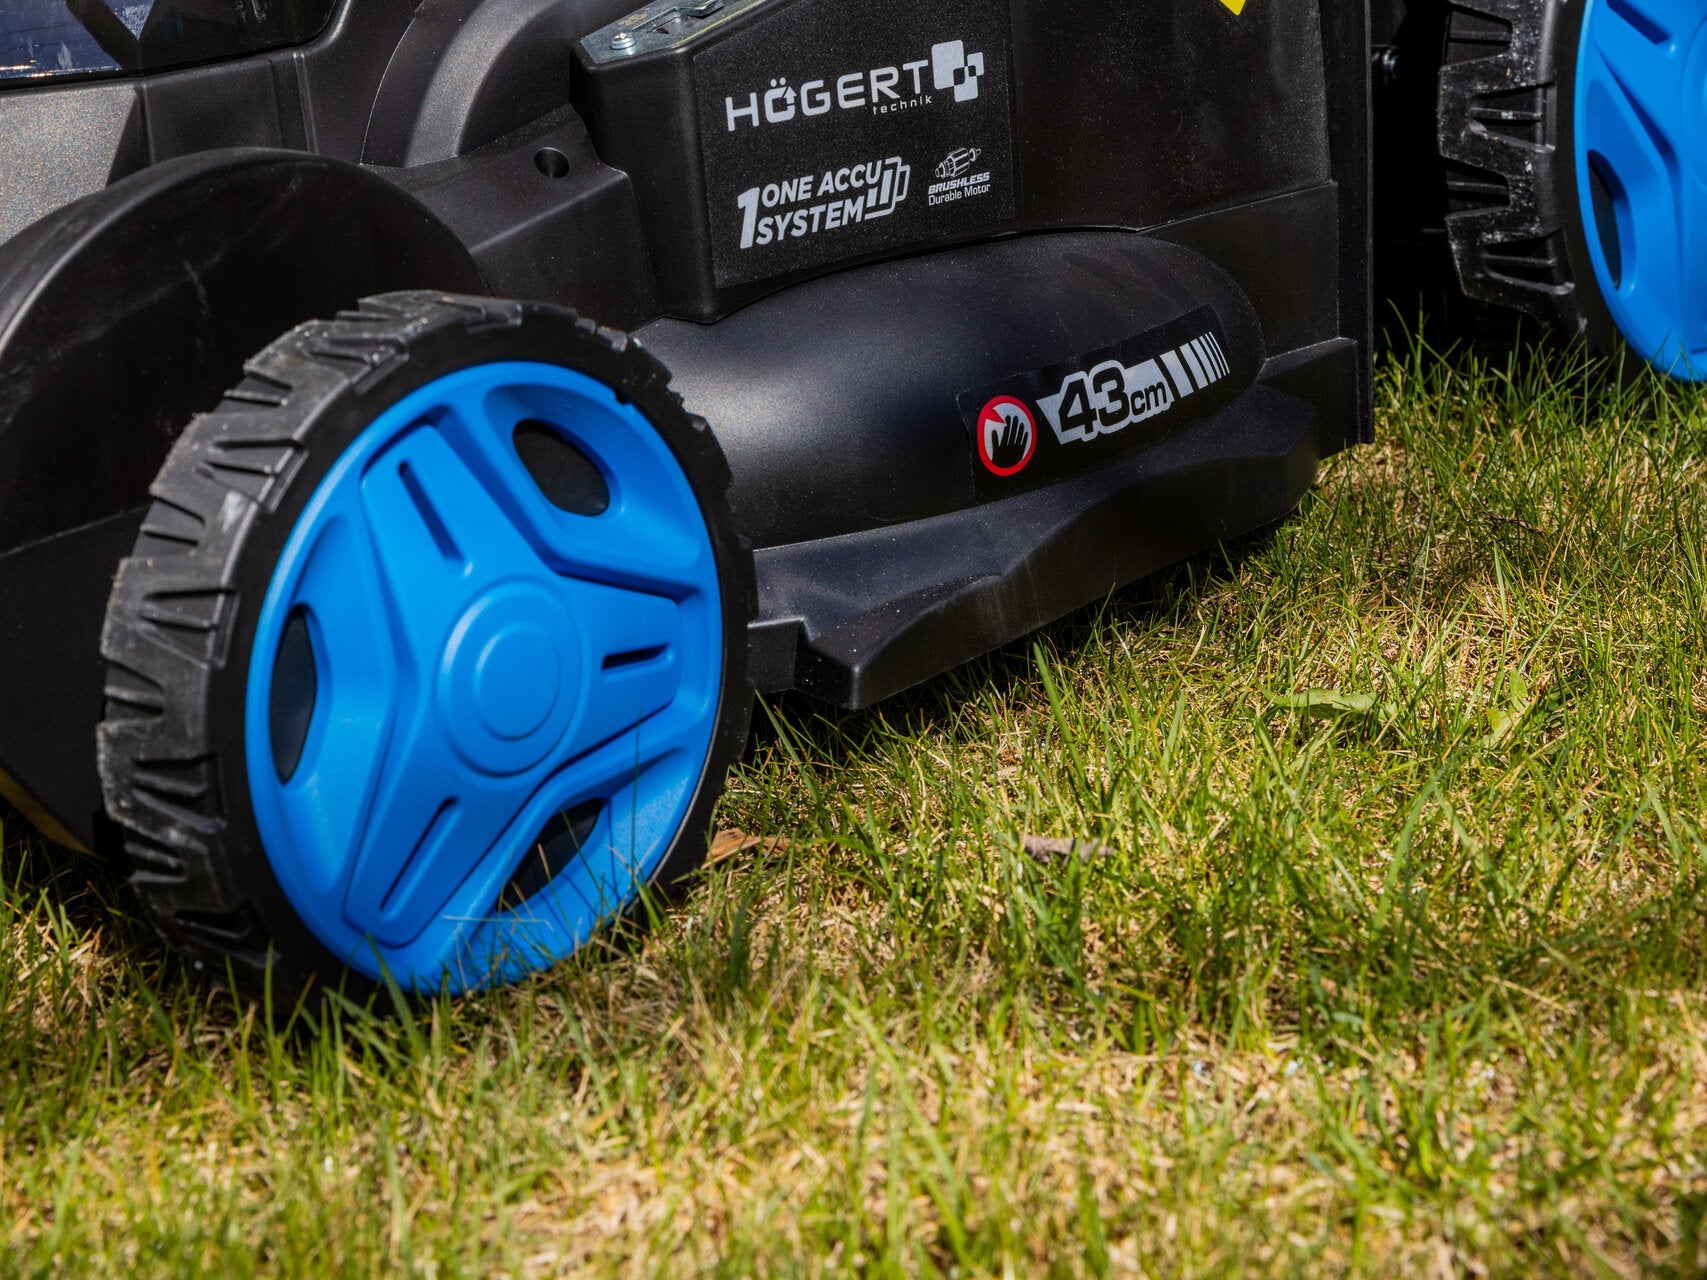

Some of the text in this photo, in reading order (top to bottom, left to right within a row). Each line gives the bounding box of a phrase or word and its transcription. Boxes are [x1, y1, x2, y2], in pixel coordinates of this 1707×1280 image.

[725, 59, 929, 132] HÖGERT
[872, 94, 933, 116] technik
[737, 160, 882, 250] 1 ONE ACCU
[928, 172, 991, 195] BRUSHLESS
[928, 183, 991, 206] Durable Motor
[755, 199, 865, 246] SYSTEM
[1058, 365, 1168, 435] 43cm
